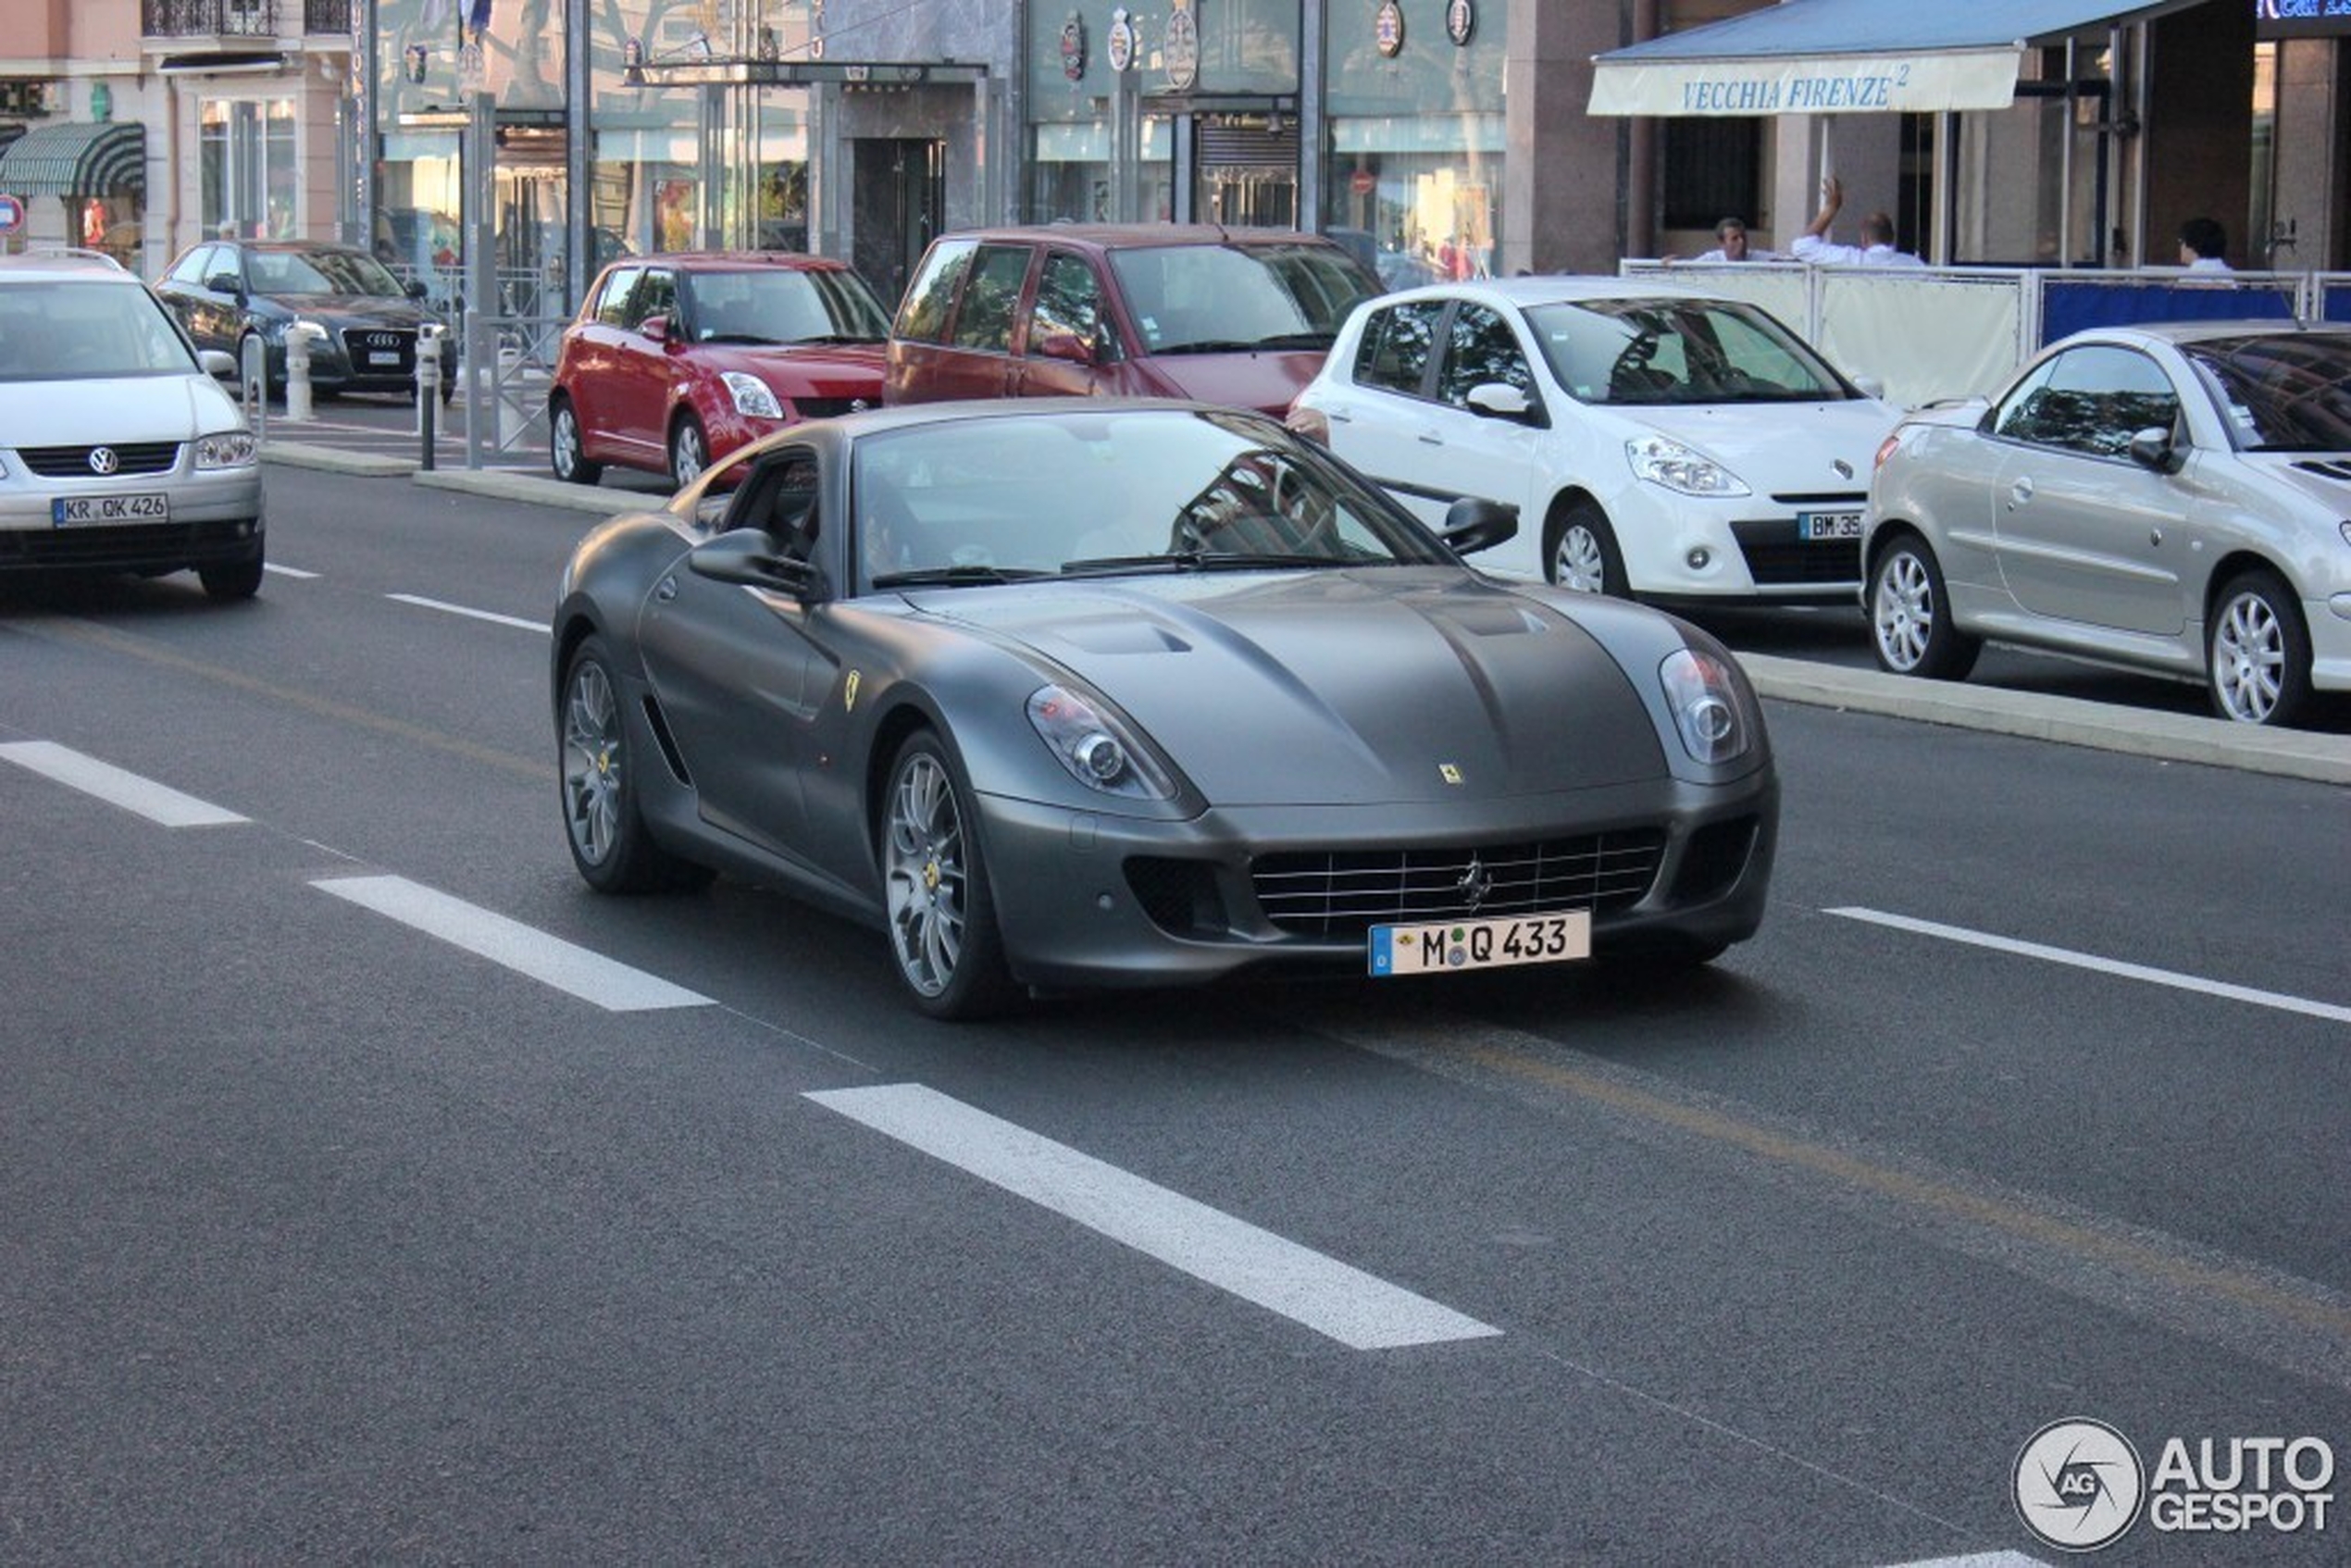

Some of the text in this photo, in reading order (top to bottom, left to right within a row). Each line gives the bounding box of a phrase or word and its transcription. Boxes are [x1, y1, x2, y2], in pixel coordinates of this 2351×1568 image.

[1683, 80, 1781, 110] VECCHIA
[1788, 77, 1892, 107] FIRENZE
[66, 498, 165, 519] KR QK 426
[1423, 929, 1445, 966] M
[1472, 926, 1493, 962] Q
[1503, 919, 1567, 959] 433
